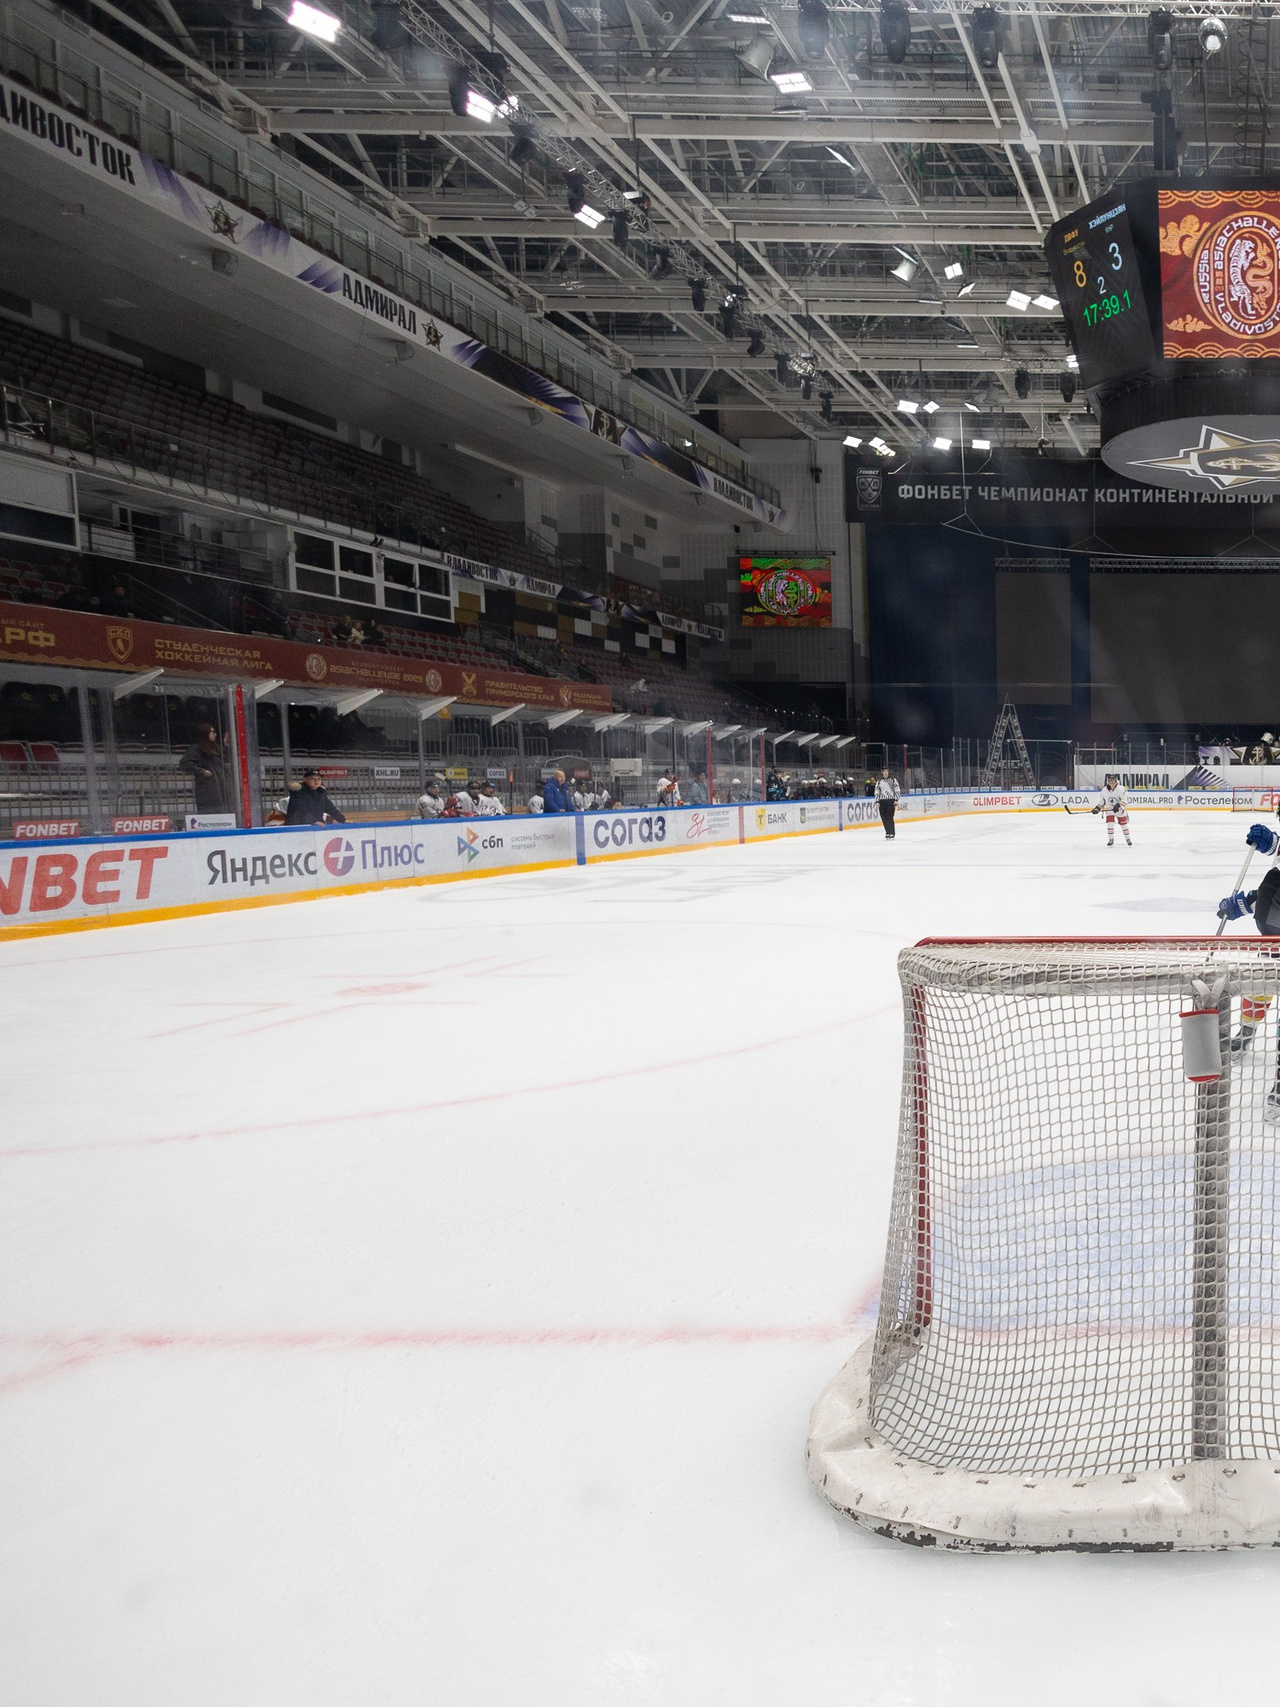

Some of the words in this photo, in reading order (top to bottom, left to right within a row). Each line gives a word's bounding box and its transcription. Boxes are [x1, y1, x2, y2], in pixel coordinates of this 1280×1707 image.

[1108, 242, 1122, 270] 3
[1073, 260, 1087, 287] 8
[1097, 276, 1106, 294] 2
[343, 273, 416, 335] АДМИРАЛ
[1083, 289, 1131, 326] 17:39.1
[898, 485, 972, 500] ФОНБЕТ
[978, 487, 1089, 503] ЧЕМПИОНАТ
[447, 556, 499, 581] ВЛАДИВОСТОК
[526, 577, 557, 597] АДМИРАЛ
[154, 638, 261, 659] СТУДЕНЧЕСКАЯ
[155, 649, 240, 668] ХОККЕЙНАЯ
[241, 661, 274, 671] ЛИГА
[485, 680, 543, 693] ПРАВИТЕЛЬСТВО
[485, 688, 538, 700] ПРИМОРСКОГО
[537, 694, 555, 702] КРАЯ
[973, 796, 1022, 806] OLIMPBET
[1061, 796, 1090, 804] LADA
[1185, 795, 1253, 805] Ростелеком
[114, 818, 168, 833] FONBET
[767, 812, 787, 824] БАНК
[16, 822, 78, 837] FONBET
[481, 834, 504, 850] сбп
[207, 847, 318, 886] Яндекс
[361, 839, 425, 869] Плюс
